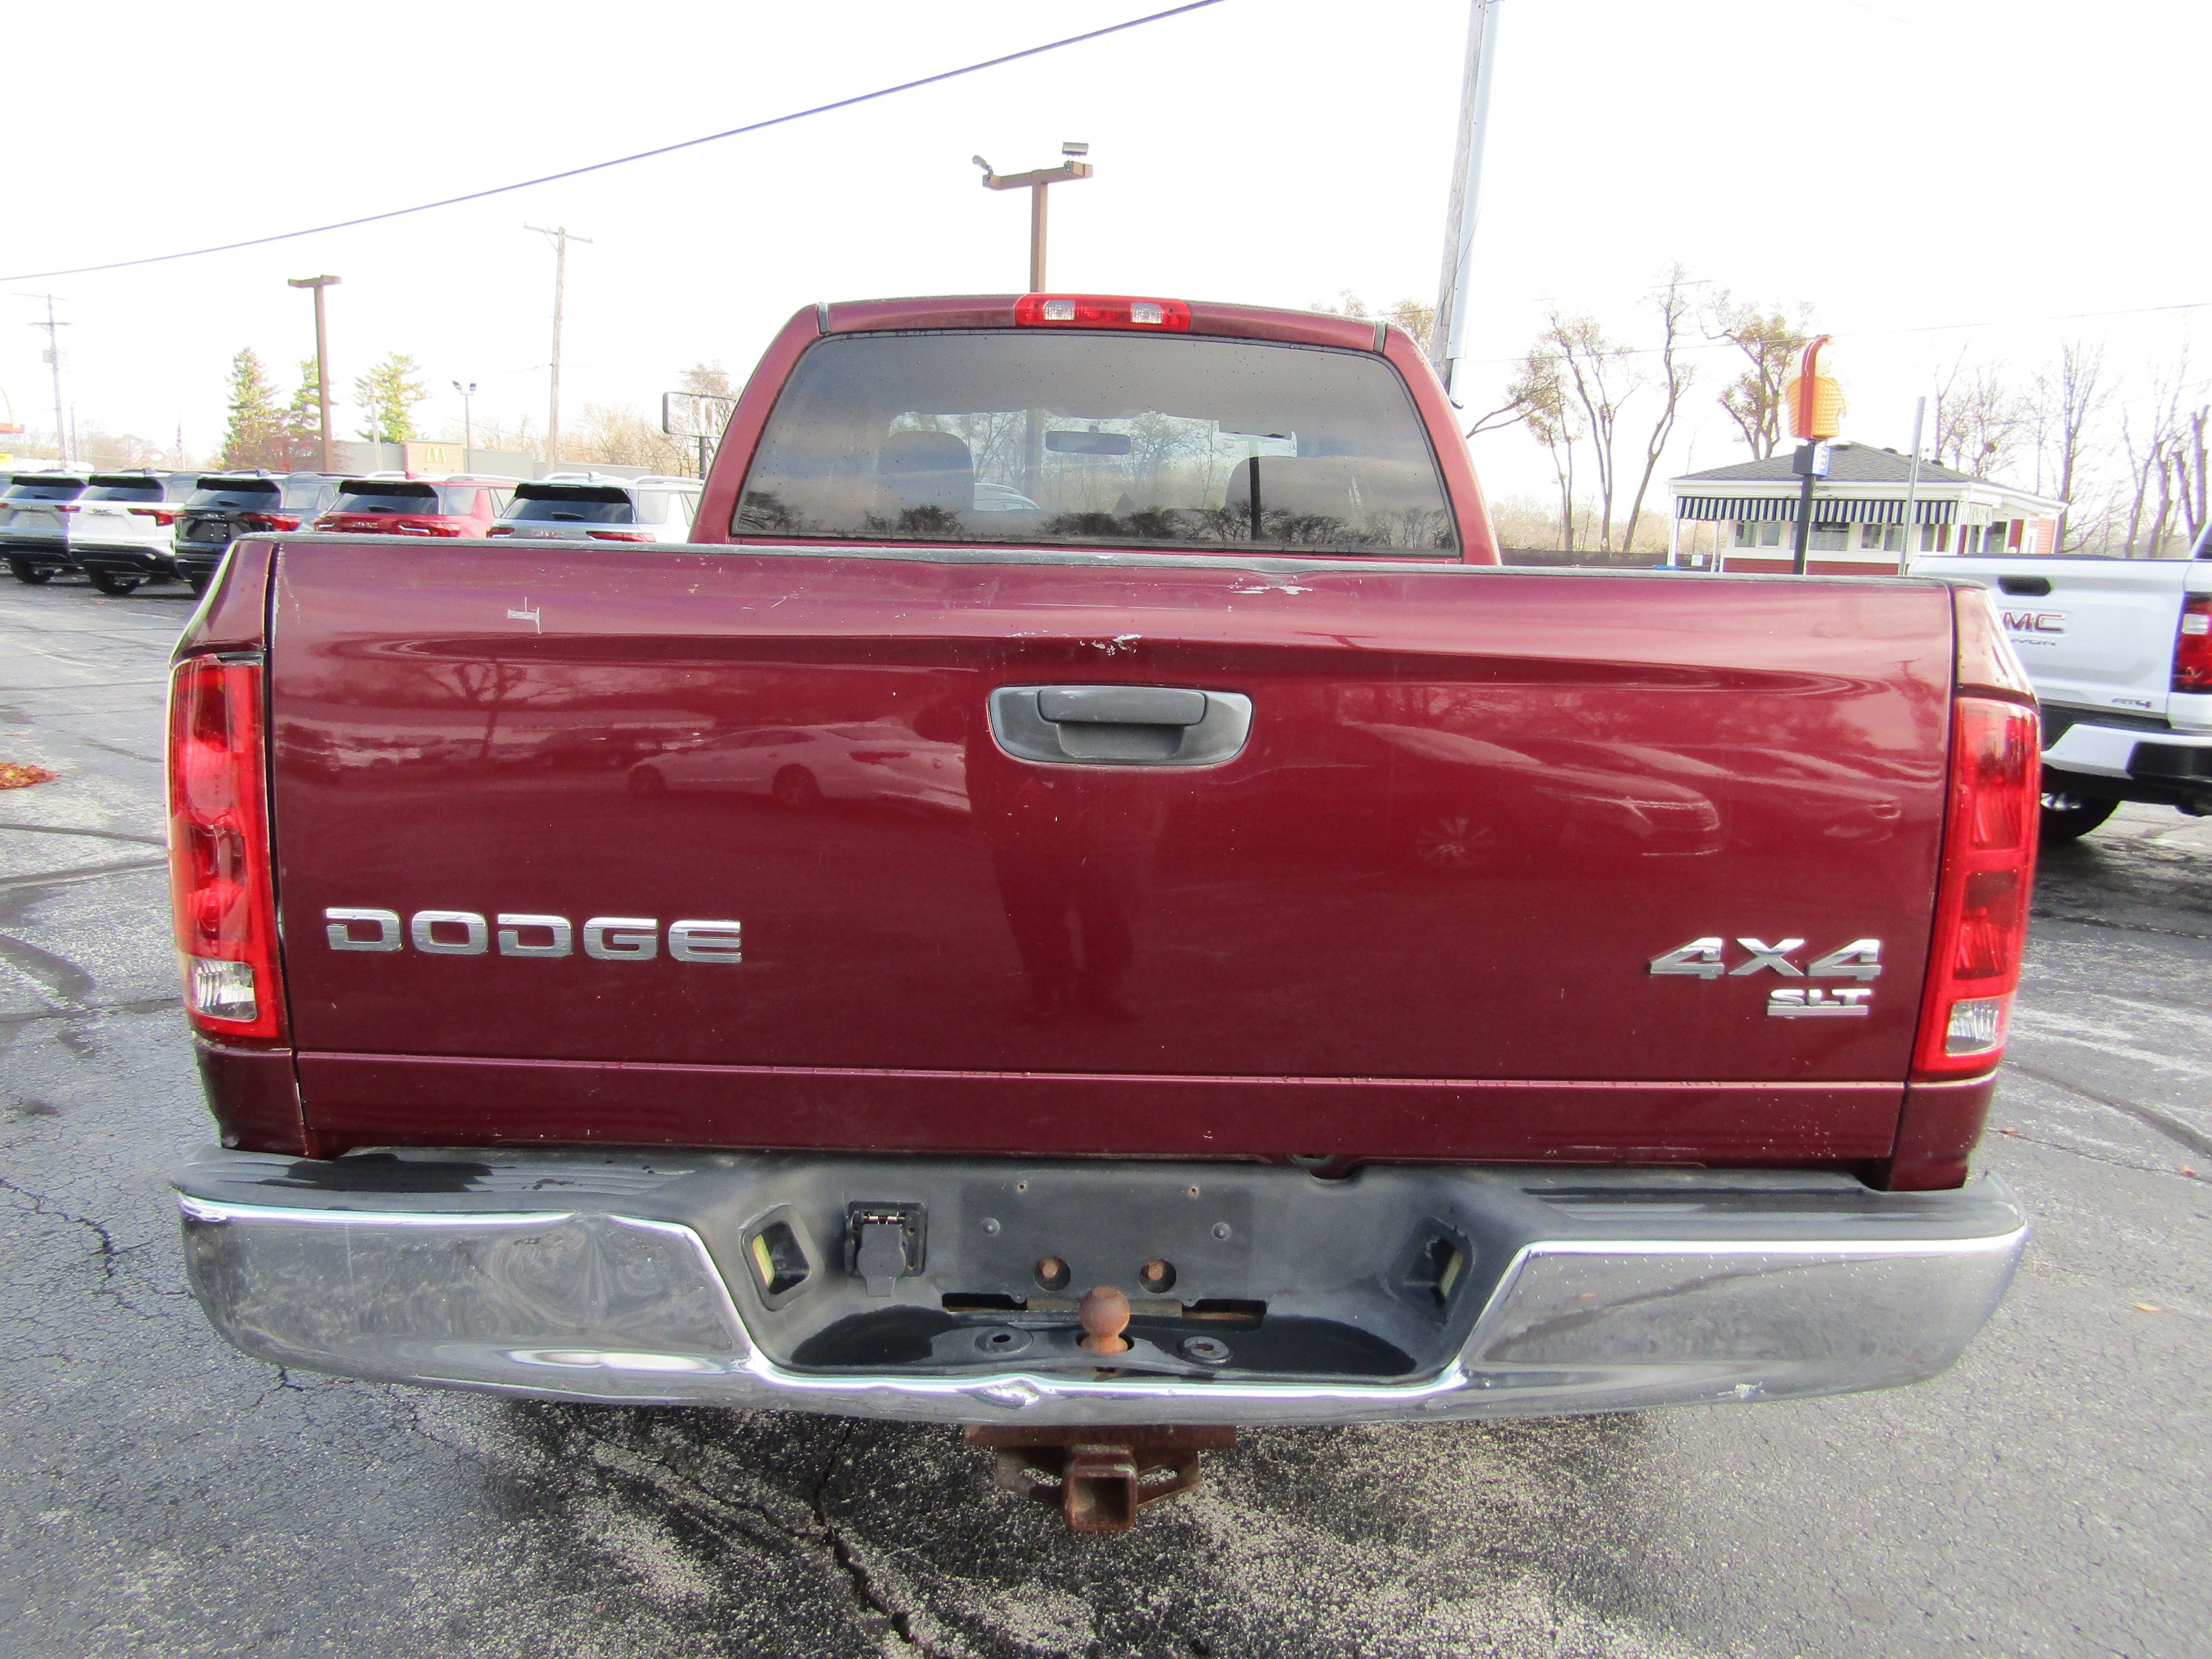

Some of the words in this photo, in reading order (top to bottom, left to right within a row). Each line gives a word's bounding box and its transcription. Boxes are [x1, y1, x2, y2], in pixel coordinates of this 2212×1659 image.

[534, 531, 565, 539] GMC
[1999, 610, 2066, 634] MC
[325, 906, 743, 964] DODGE
[1649, 936, 1882, 981] 4X4
[1768, 988, 1872, 1008] SLT
